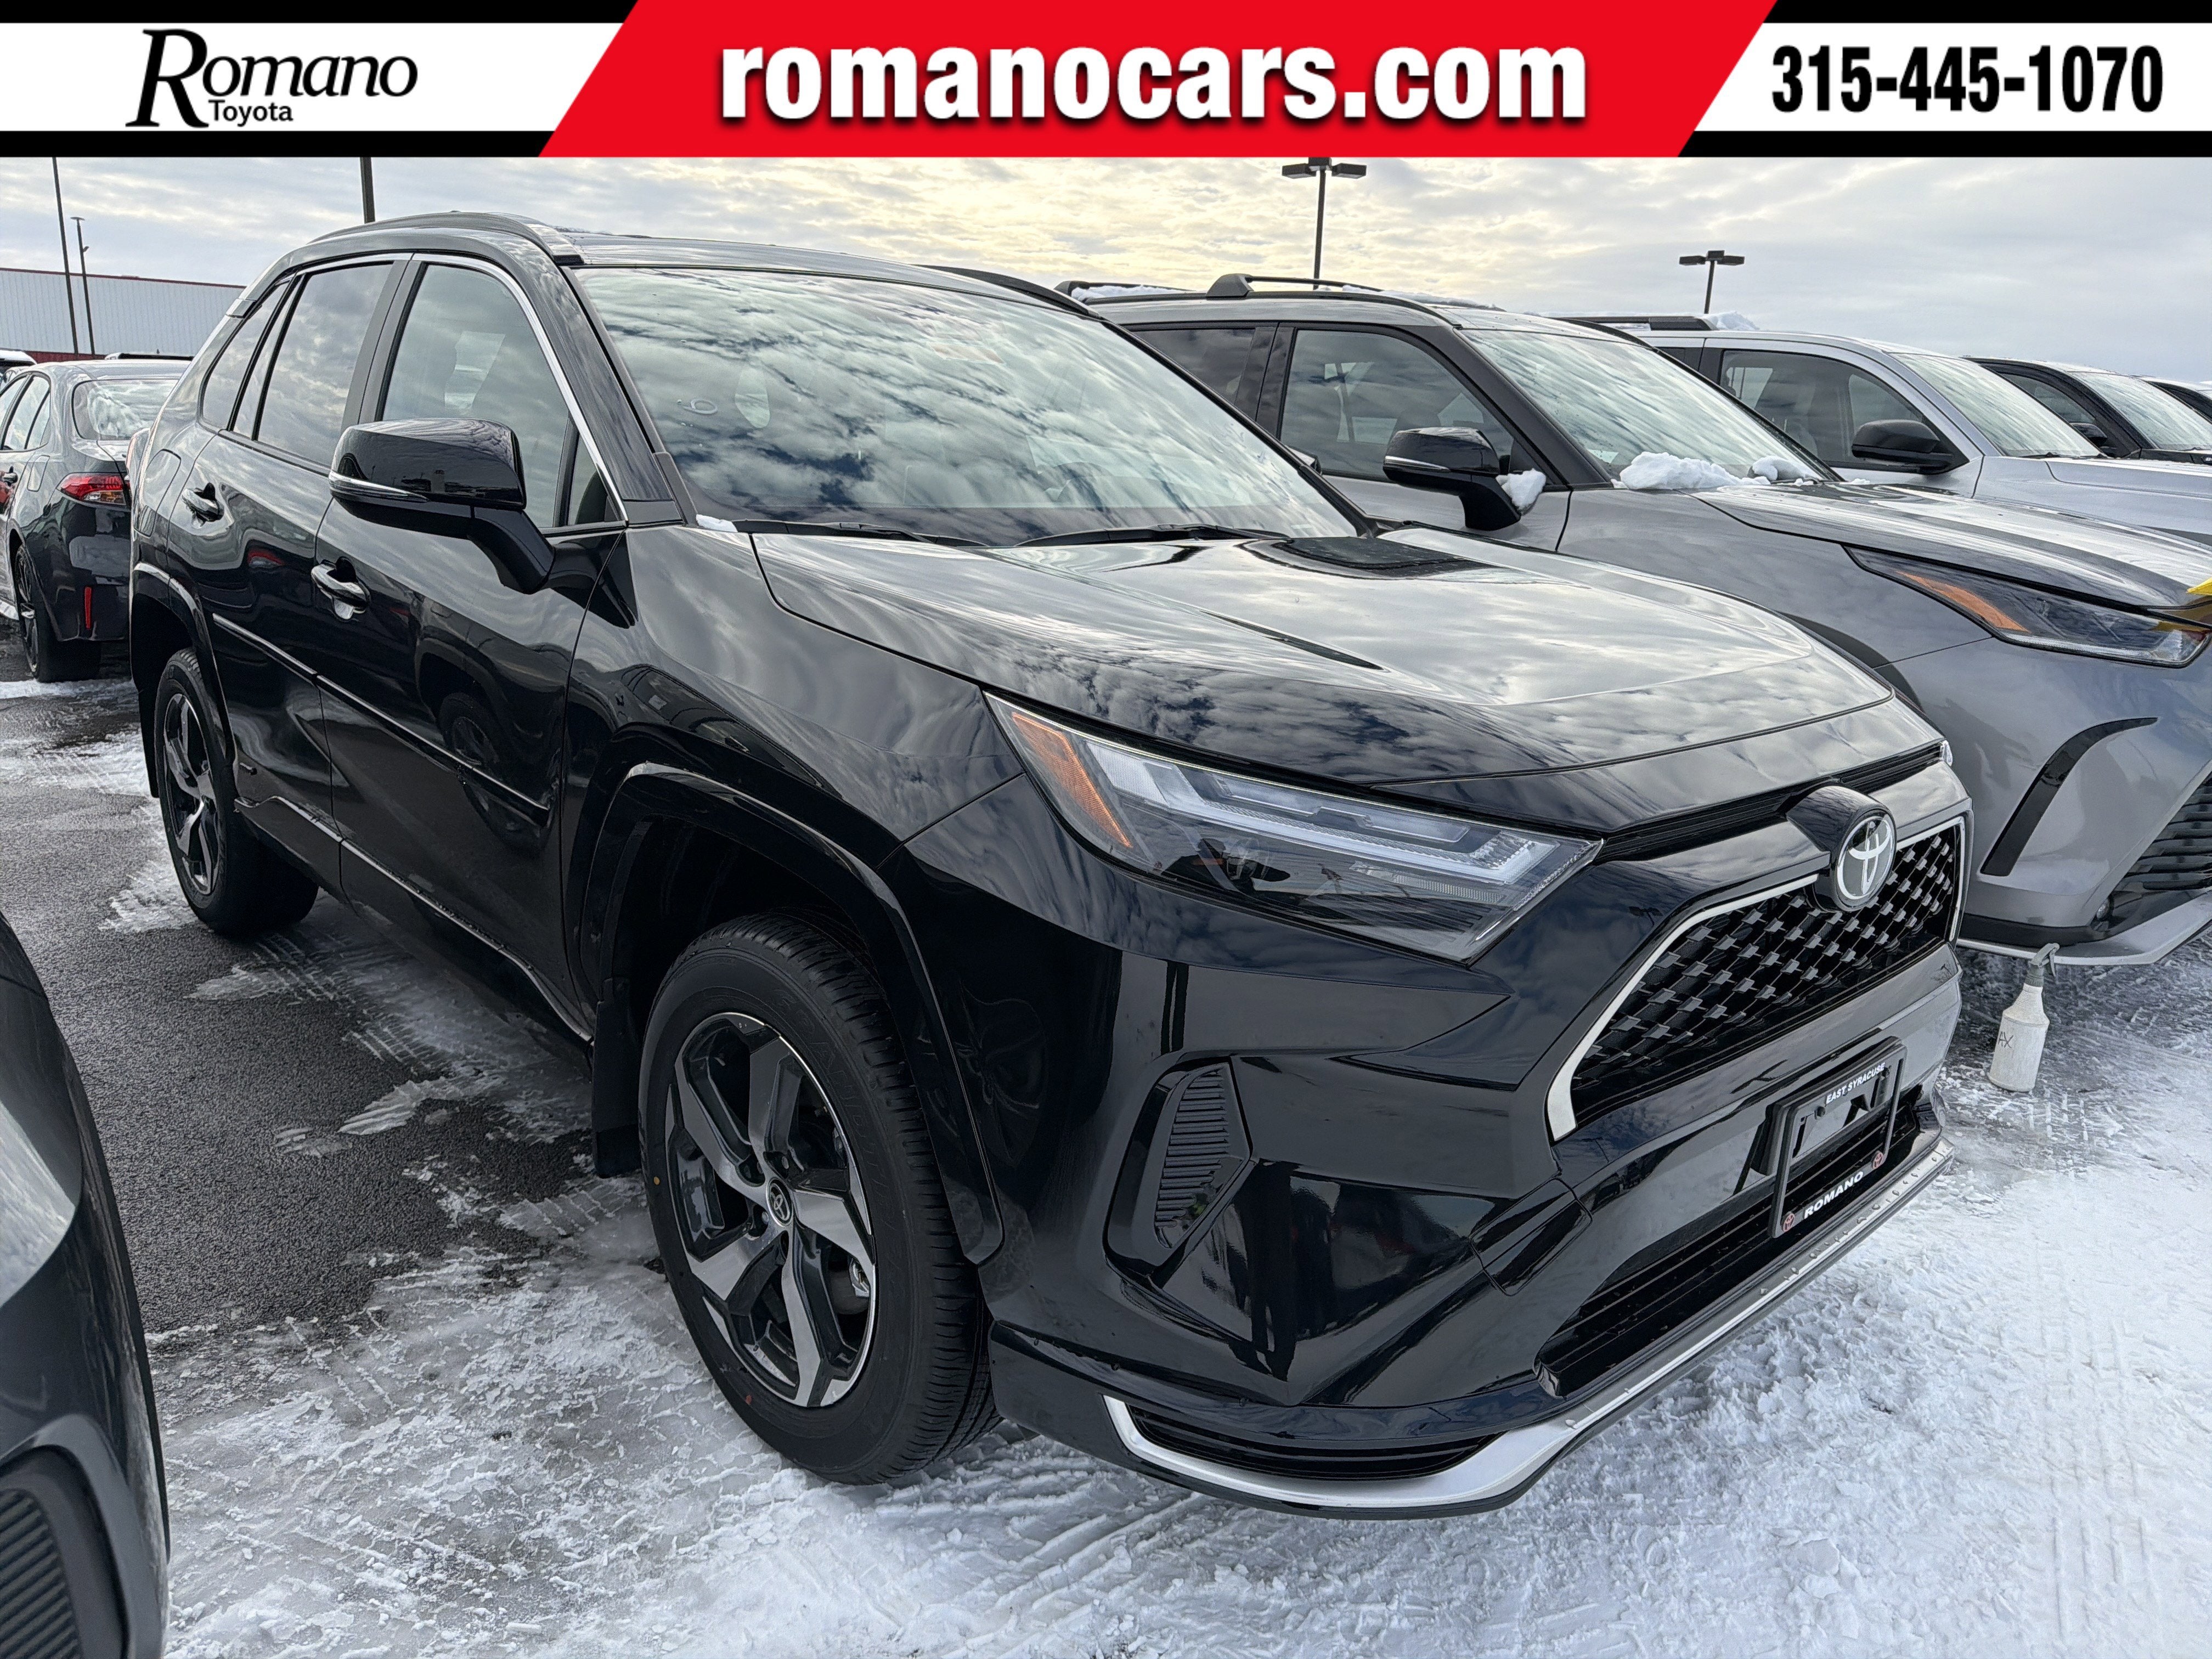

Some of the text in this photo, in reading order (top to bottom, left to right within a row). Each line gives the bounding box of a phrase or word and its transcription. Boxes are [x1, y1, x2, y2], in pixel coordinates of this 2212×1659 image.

[1826, 1062, 1886, 1104] EAST SYRACUSE
[1804, 1171, 1864, 1219] ROMANO
